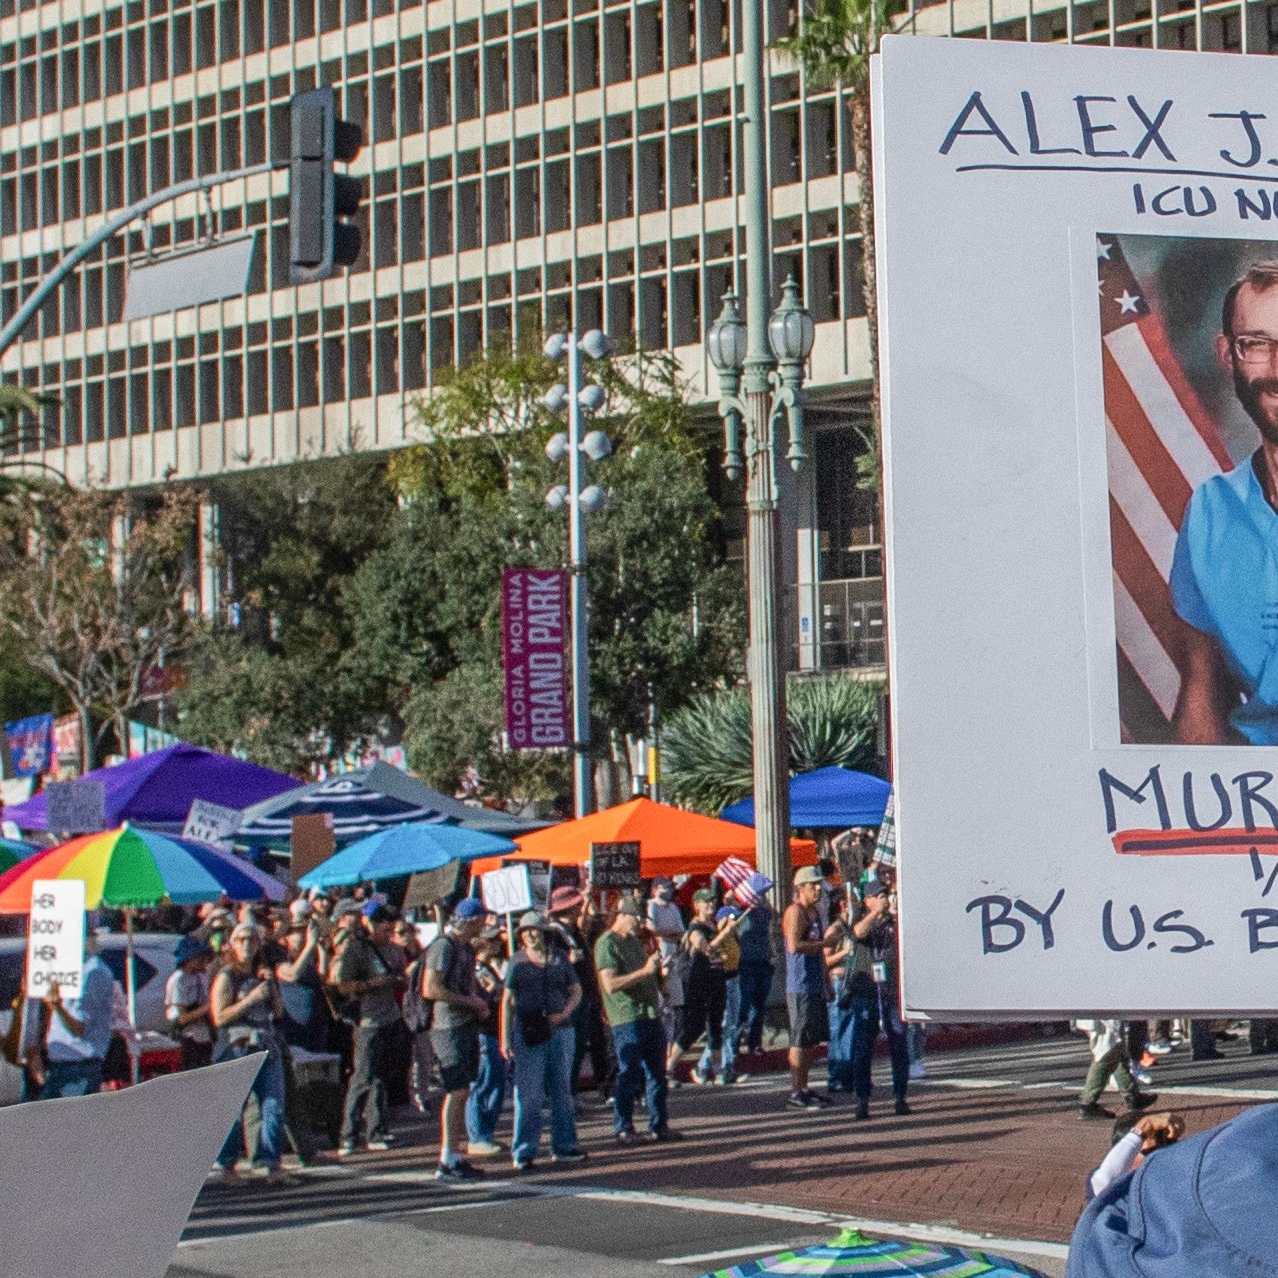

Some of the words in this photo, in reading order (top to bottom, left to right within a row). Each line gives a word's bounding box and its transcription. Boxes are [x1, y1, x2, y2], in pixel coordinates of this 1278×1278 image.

[938, 91, 1177, 162] ALEX
[1133, 183, 1217, 217] ICU
[509, 574, 524, 655] MOLINA
[527, 573, 562, 644] PARK
[511, 664, 527, 743] GLORIA
[528, 652, 565, 744] GRAND
[32, 919, 63, 934] BODY
[34, 893, 56, 909] HER
[965, 889, 1065, 955] BY
[1100, 901, 1215, 954] U.S.
[34, 945, 56, 961] HER
